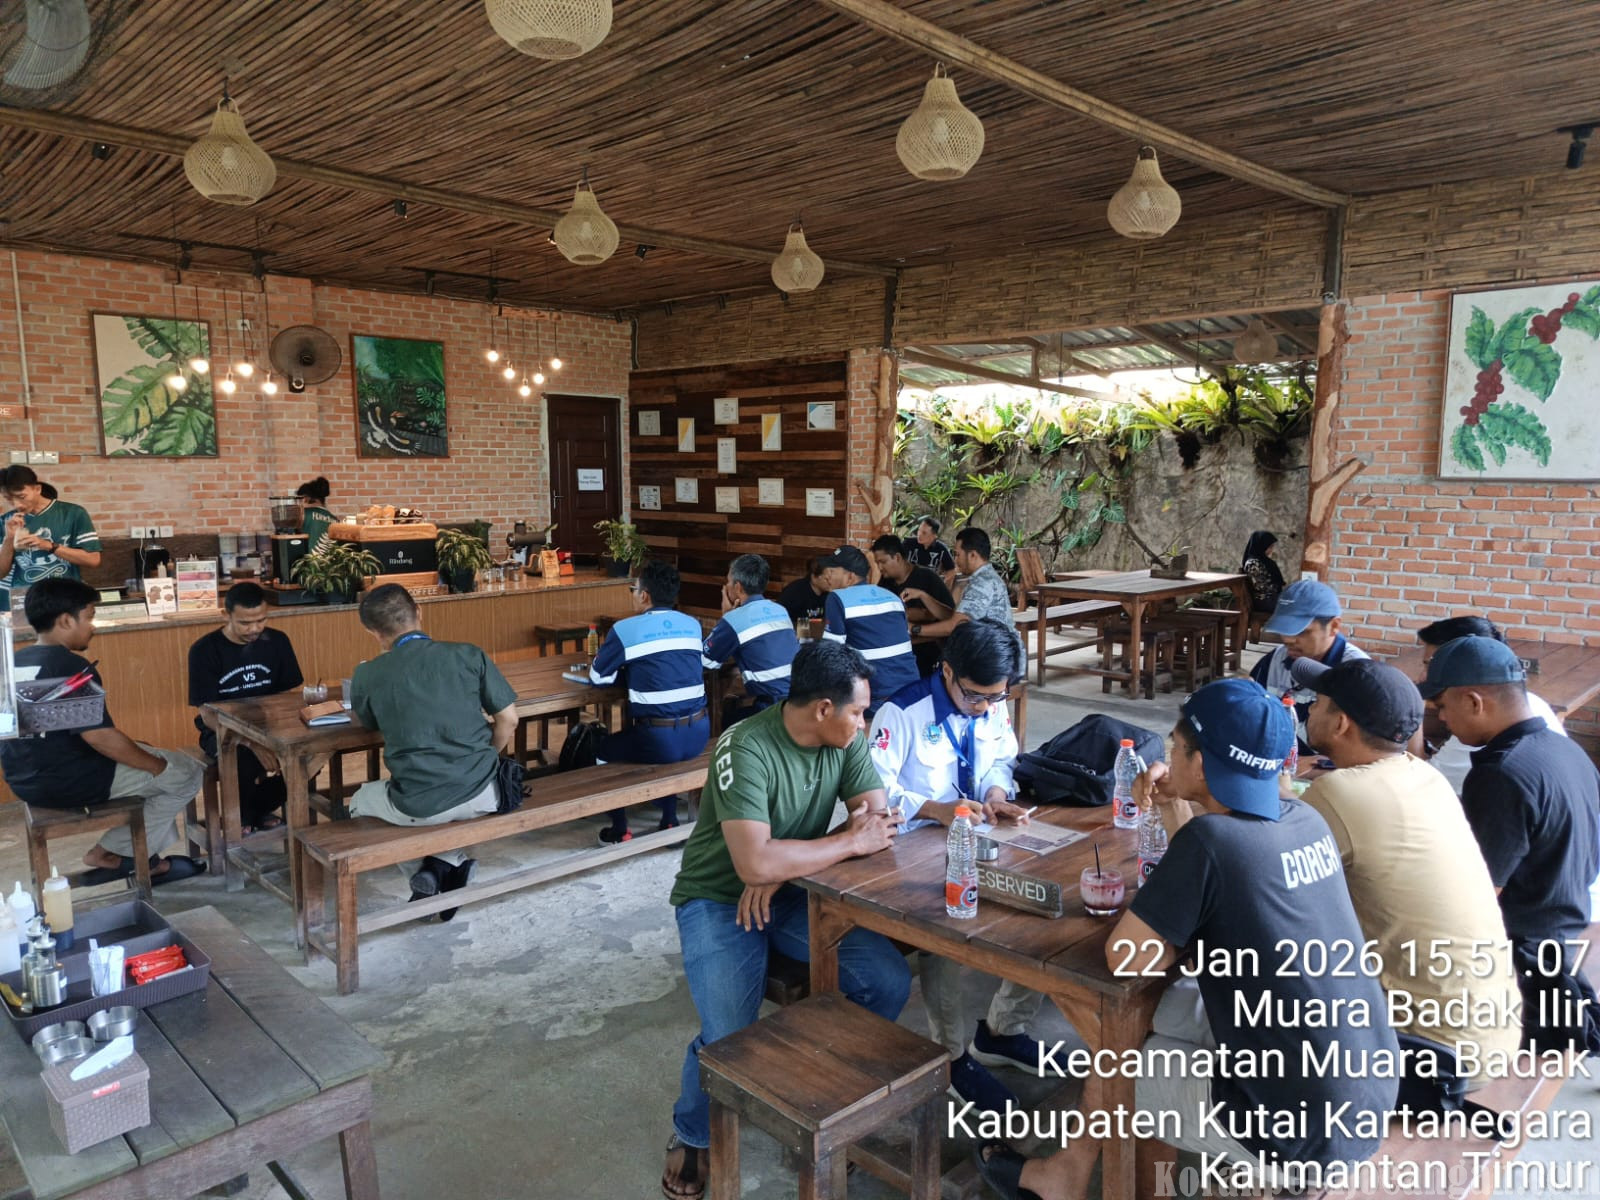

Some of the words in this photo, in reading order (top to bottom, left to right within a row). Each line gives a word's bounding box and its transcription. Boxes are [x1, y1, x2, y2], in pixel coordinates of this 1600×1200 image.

[243, 672, 256, 681] VS
[1280, 834, 1340, 889] COACH
[977, 868, 1046, 902] ESERVED
